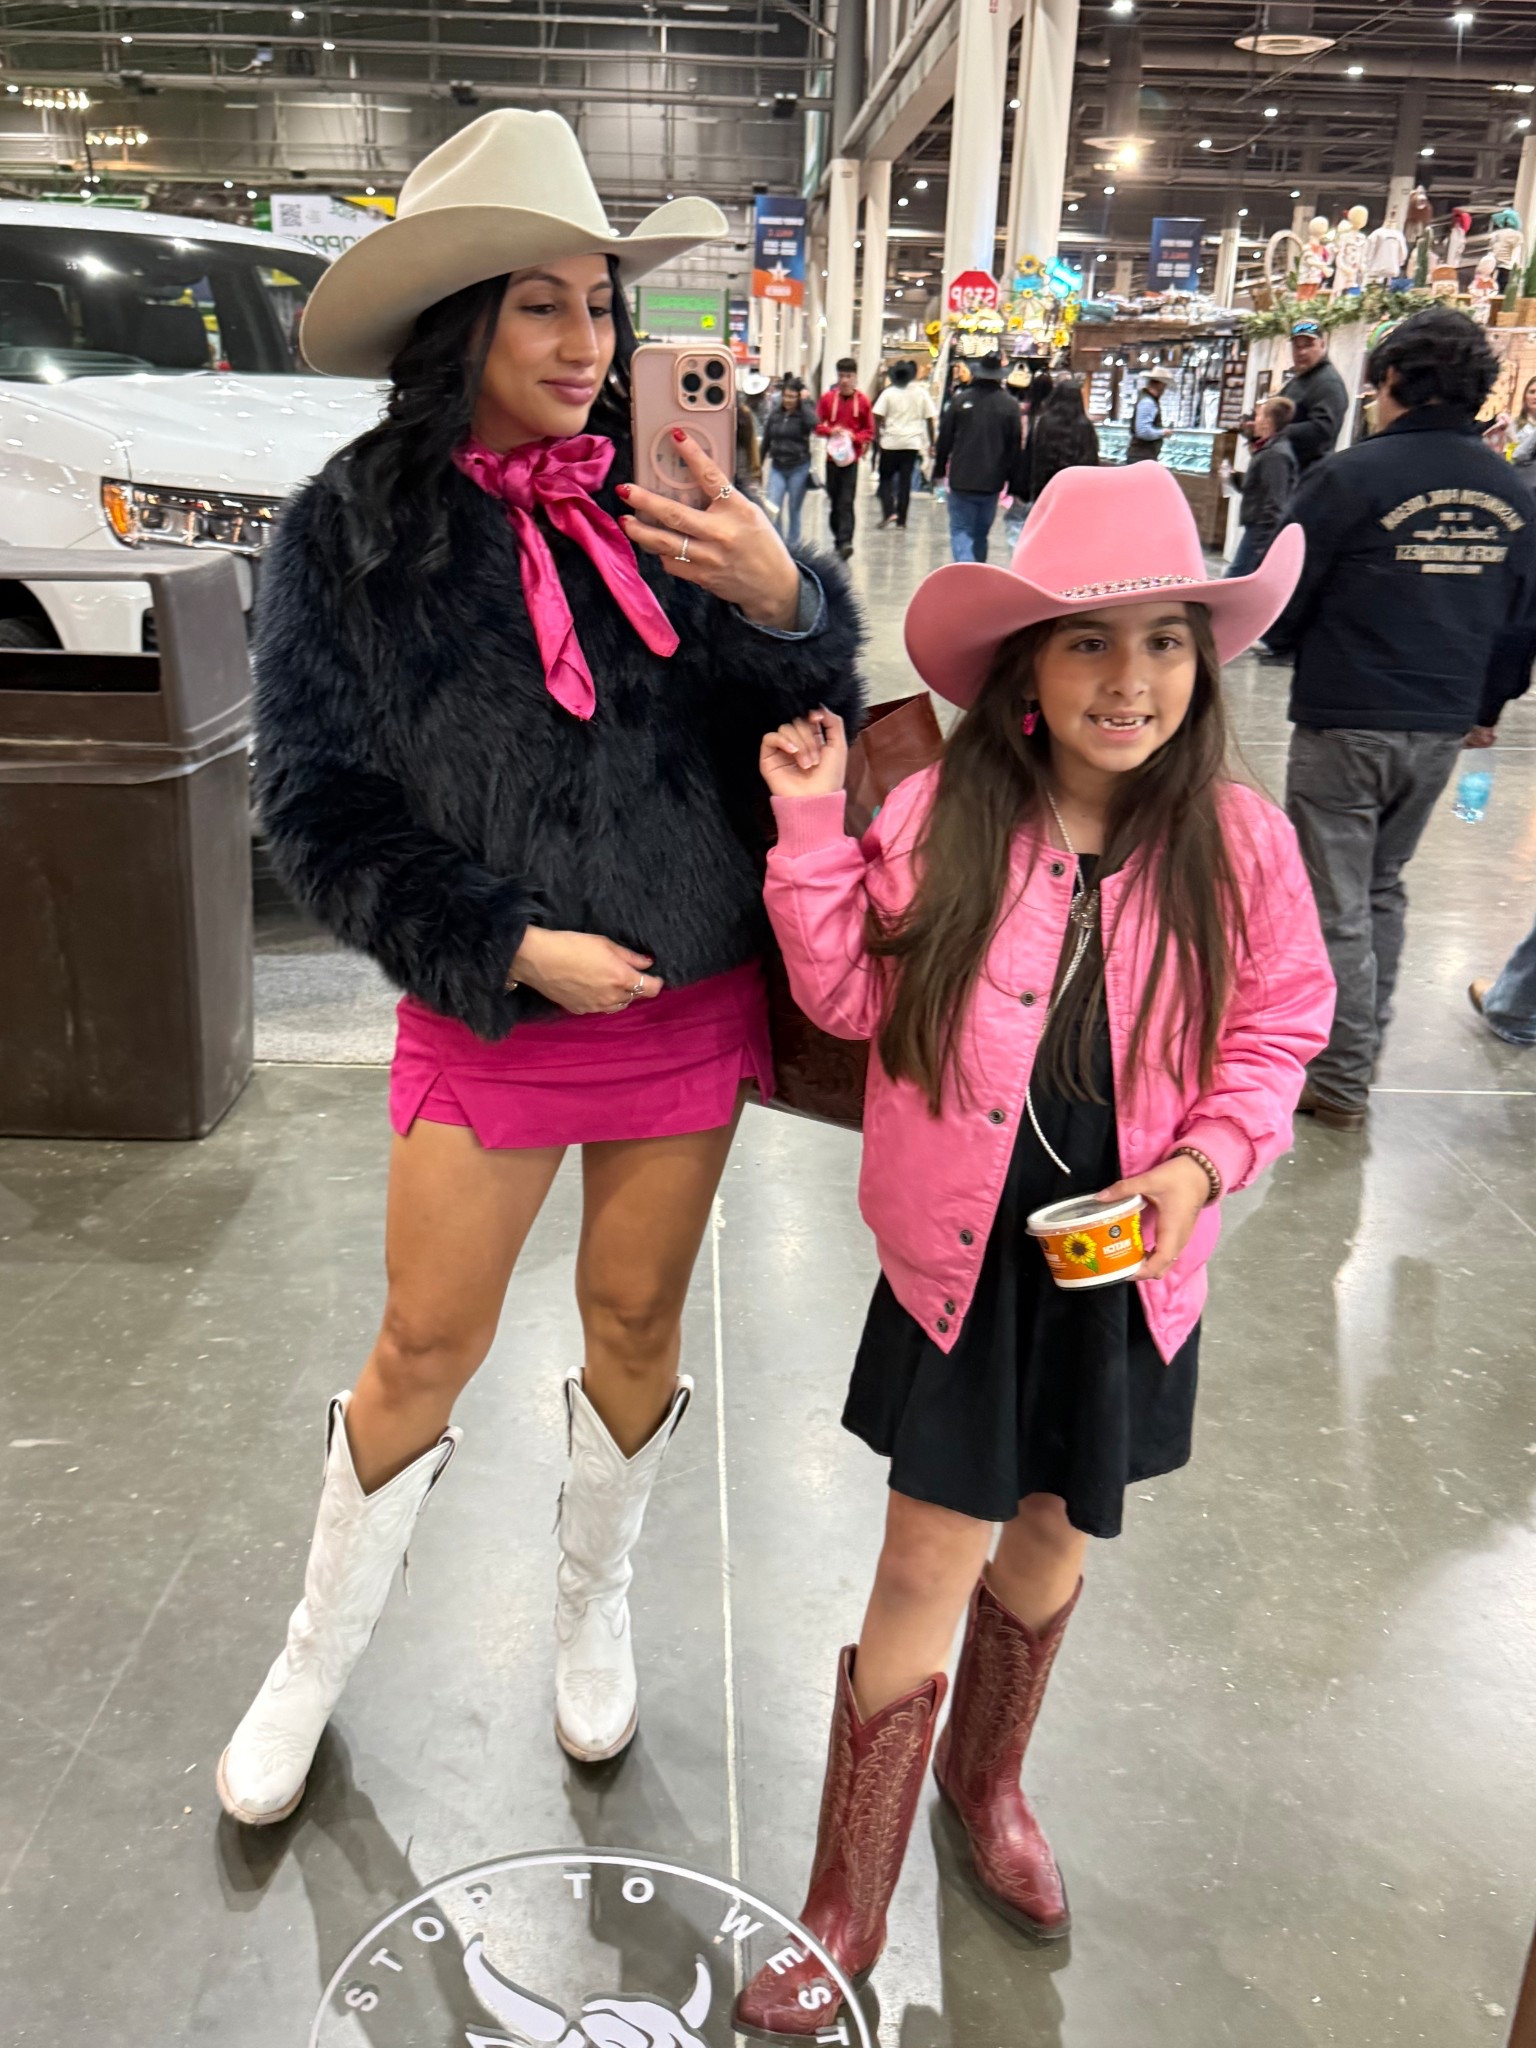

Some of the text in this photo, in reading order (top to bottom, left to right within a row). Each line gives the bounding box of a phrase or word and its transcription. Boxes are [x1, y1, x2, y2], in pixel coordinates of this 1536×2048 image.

[344, 1873, 850, 2046] STOP TO WEST
